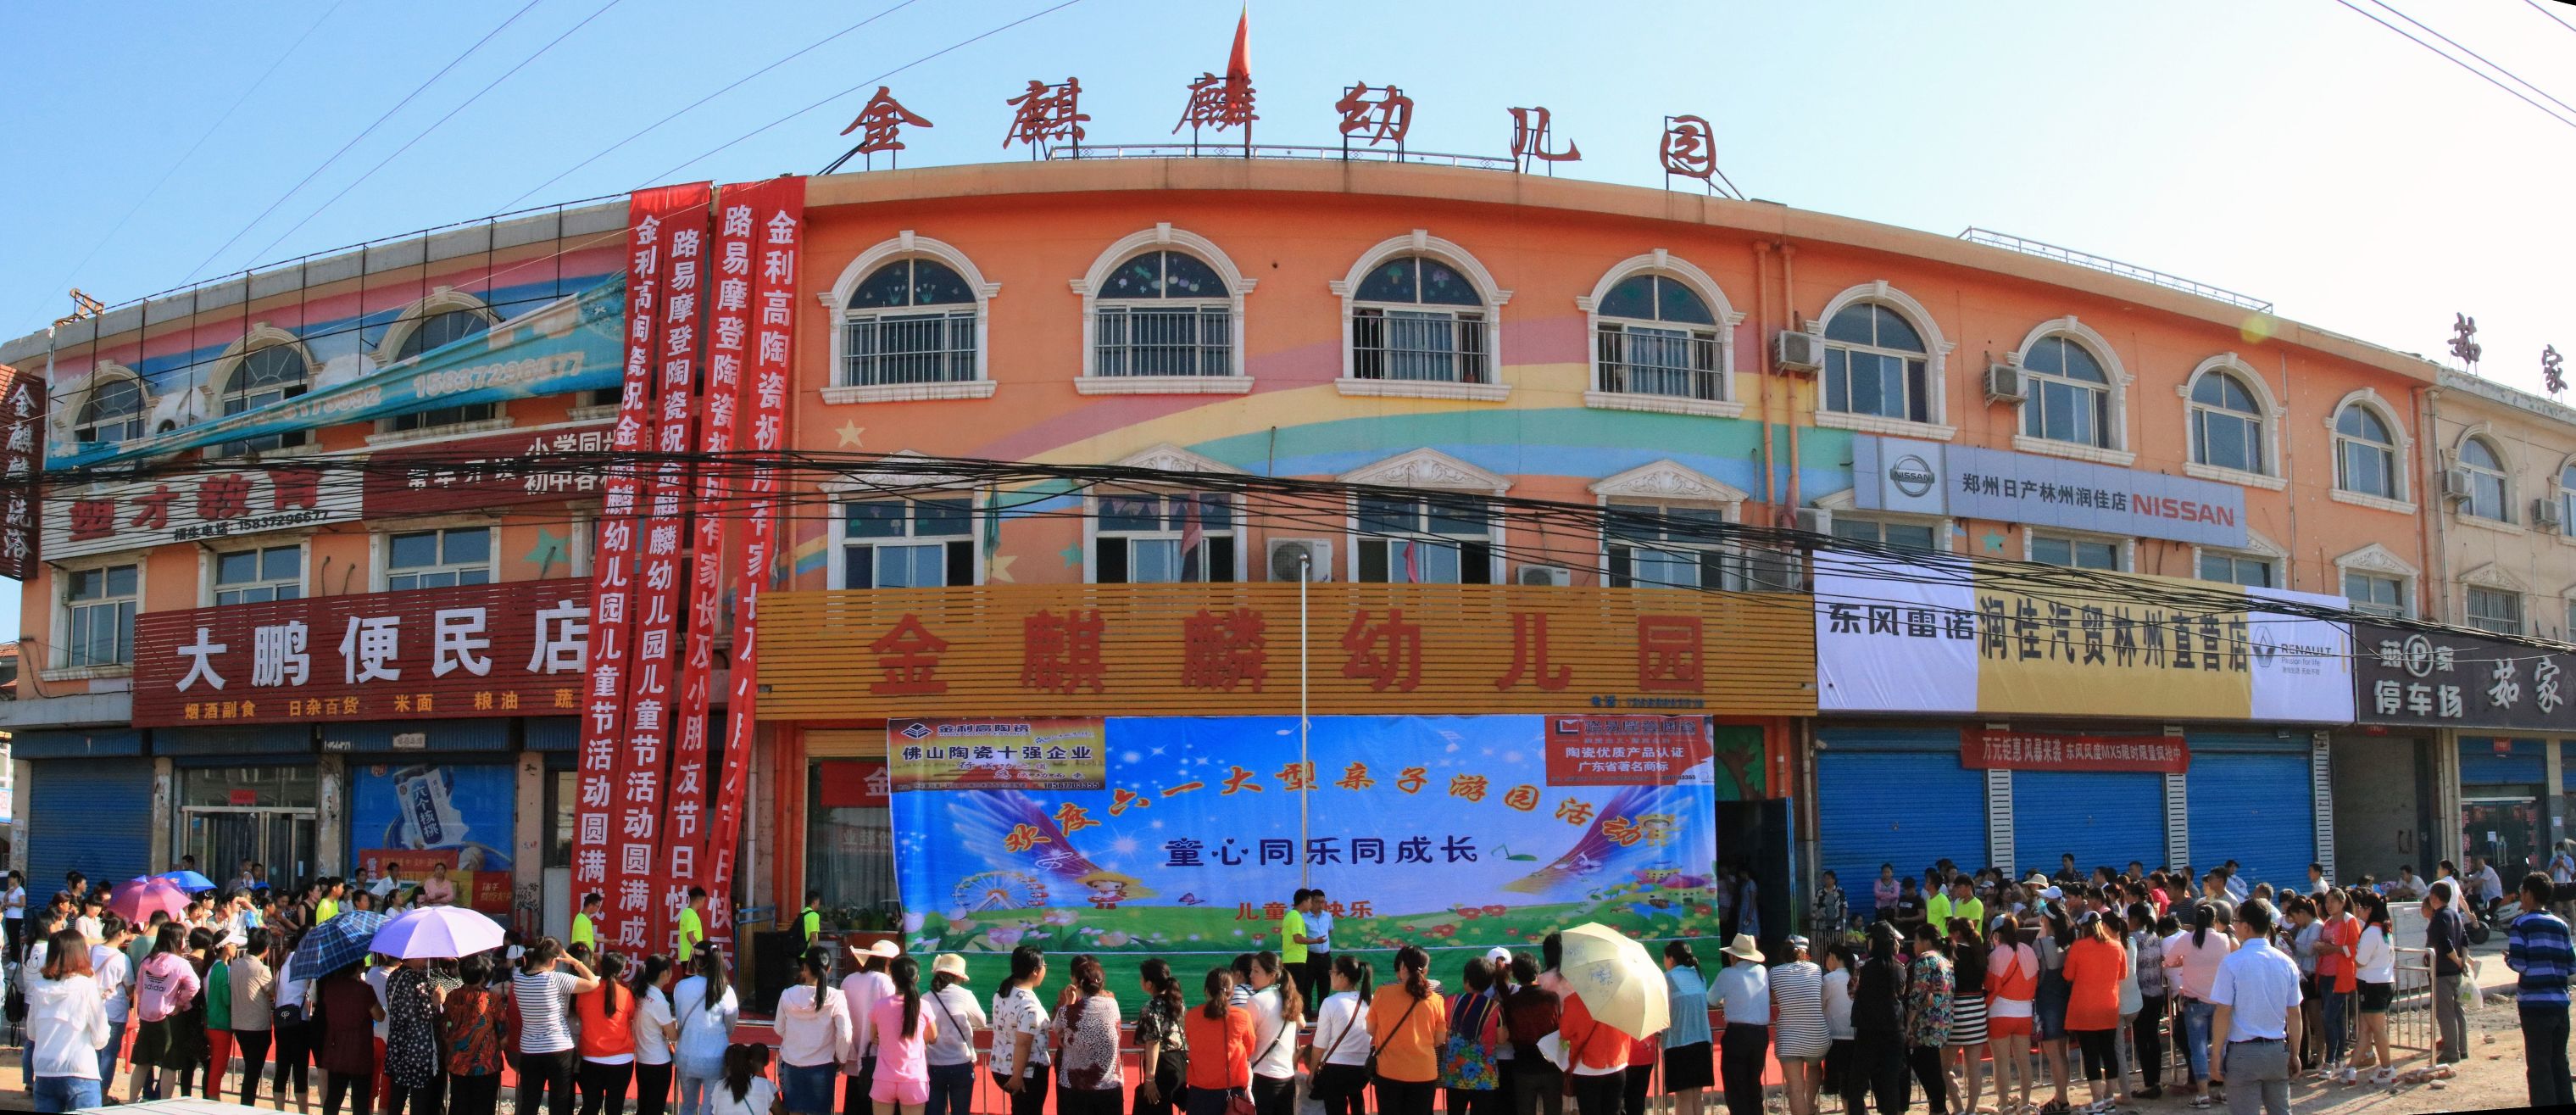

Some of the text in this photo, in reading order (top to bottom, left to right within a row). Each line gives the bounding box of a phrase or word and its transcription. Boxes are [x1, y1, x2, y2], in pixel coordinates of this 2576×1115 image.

[840, 71, 1717, 177] 金麒麟幼儿园
[1894, 471, 1931, 482] NISSAN
[1962, 471, 2128, 513] 郑州日产林州润佳店
[2132, 493, 2235, 527] NISSAN
[665, 204, 754, 962] 路易摩登陶瓷祝有家长及小朋友节日快
[707, 209, 797, 972] 金利高陶瓷祝有家快
[1828, 601, 1975, 642] 东风雷诺
[1978, 594, 2249, 674] 润佳汽贸林州直营店
[175, 599, 591, 693] 大鹏便民店
[869, 607, 1705, 694] 金麒麟幼儿园
[2280, 643, 2332, 656] RENAULT
[185, 700, 256, 720] 烟酒副食
[289, 696, 359, 716] 日杂百货
[394, 694, 434, 713] 米面
[474, 690, 519, 711] 粮油
[2374, 680, 2463, 719] 停车场
[902, 745, 1093, 761] 佛山陶瓷十强企业
[1566, 746, 1685, 759] 陶瓷优质产品认证
[1577, 761, 1669, 772] 广东省著名商标
[412, 785, 440, 838] 六个核桃
[1003, 760, 1642, 854] 欢度六一大型亲子游园活动
[1165, 835, 1478, 867] 童心同乐同成长
[1235, 900, 1373, 922] 儿童快乐
